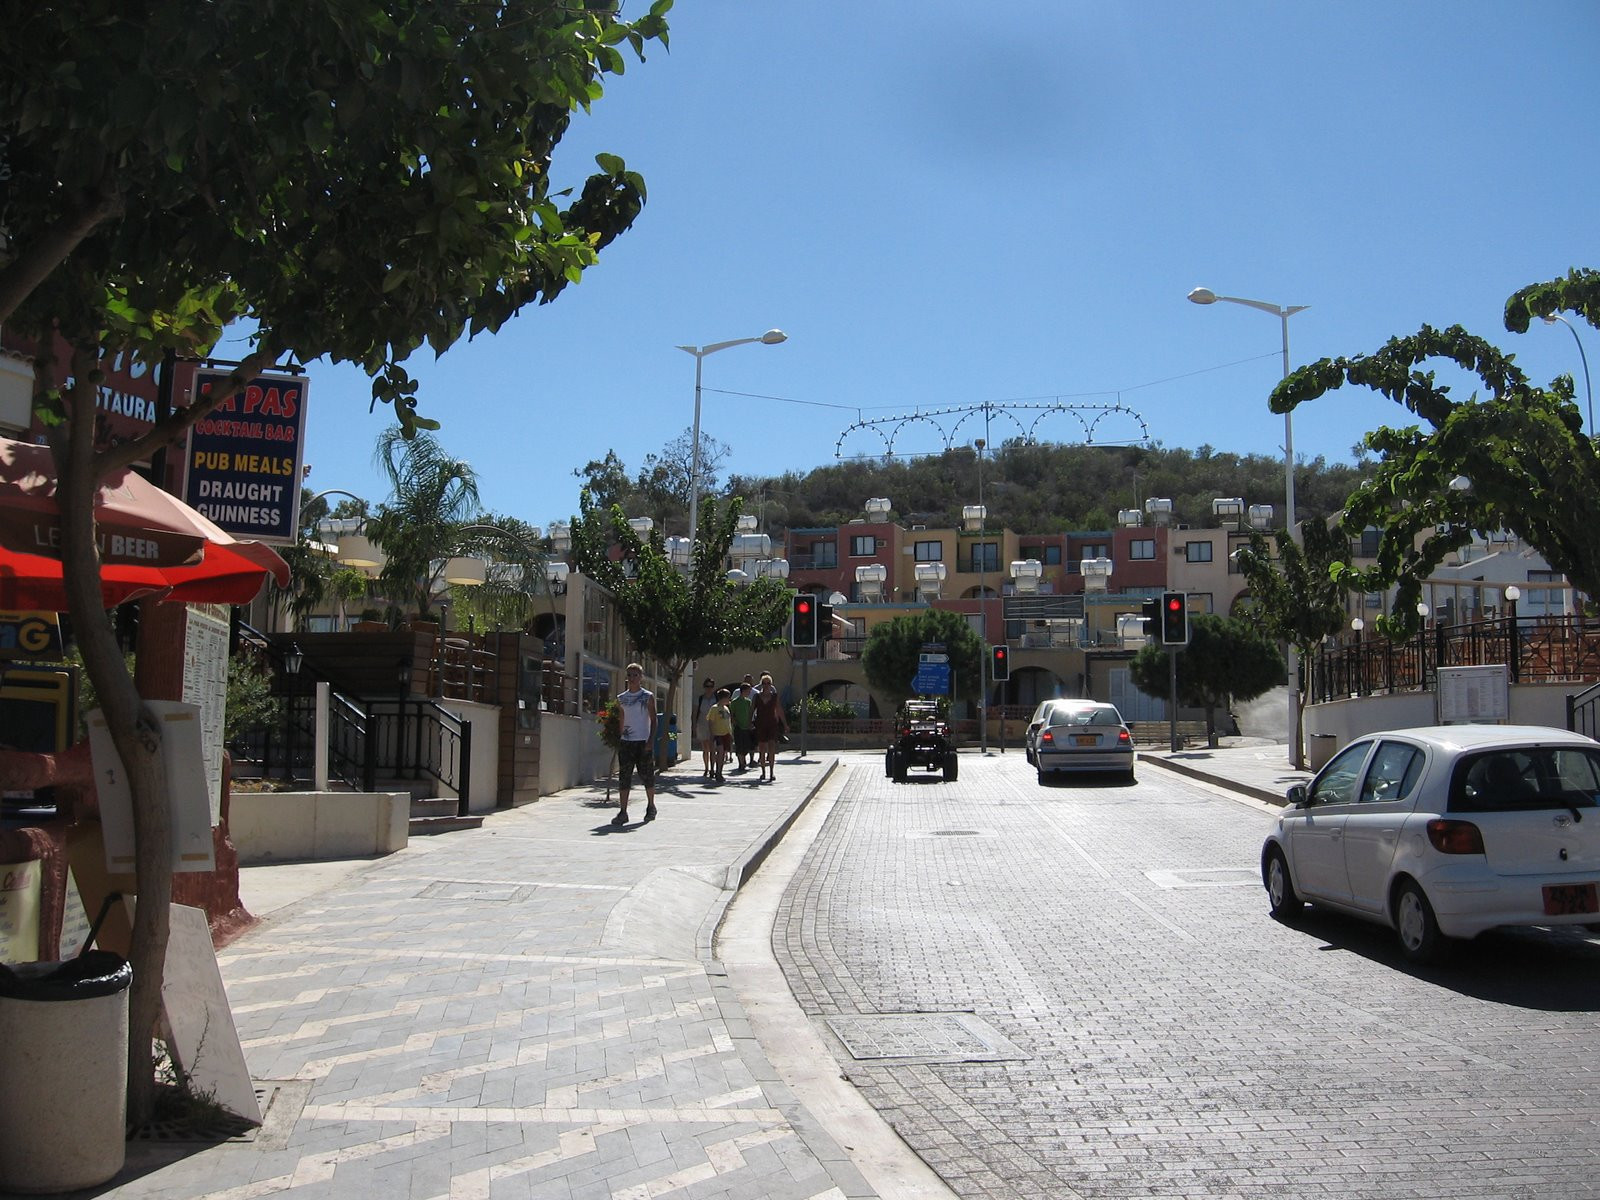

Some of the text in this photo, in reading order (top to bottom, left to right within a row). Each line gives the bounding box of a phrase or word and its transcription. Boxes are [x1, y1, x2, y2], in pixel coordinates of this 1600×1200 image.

[243, 385, 298, 418] PAS
[195, 419, 295, 442] COCKTAIL BAR
[194, 451, 293, 476] PUB MEALS
[199, 480, 283, 502] DRAUGHT
[197, 503, 280, 526] GUINNESS
[111, 534, 159, 559] BEER
